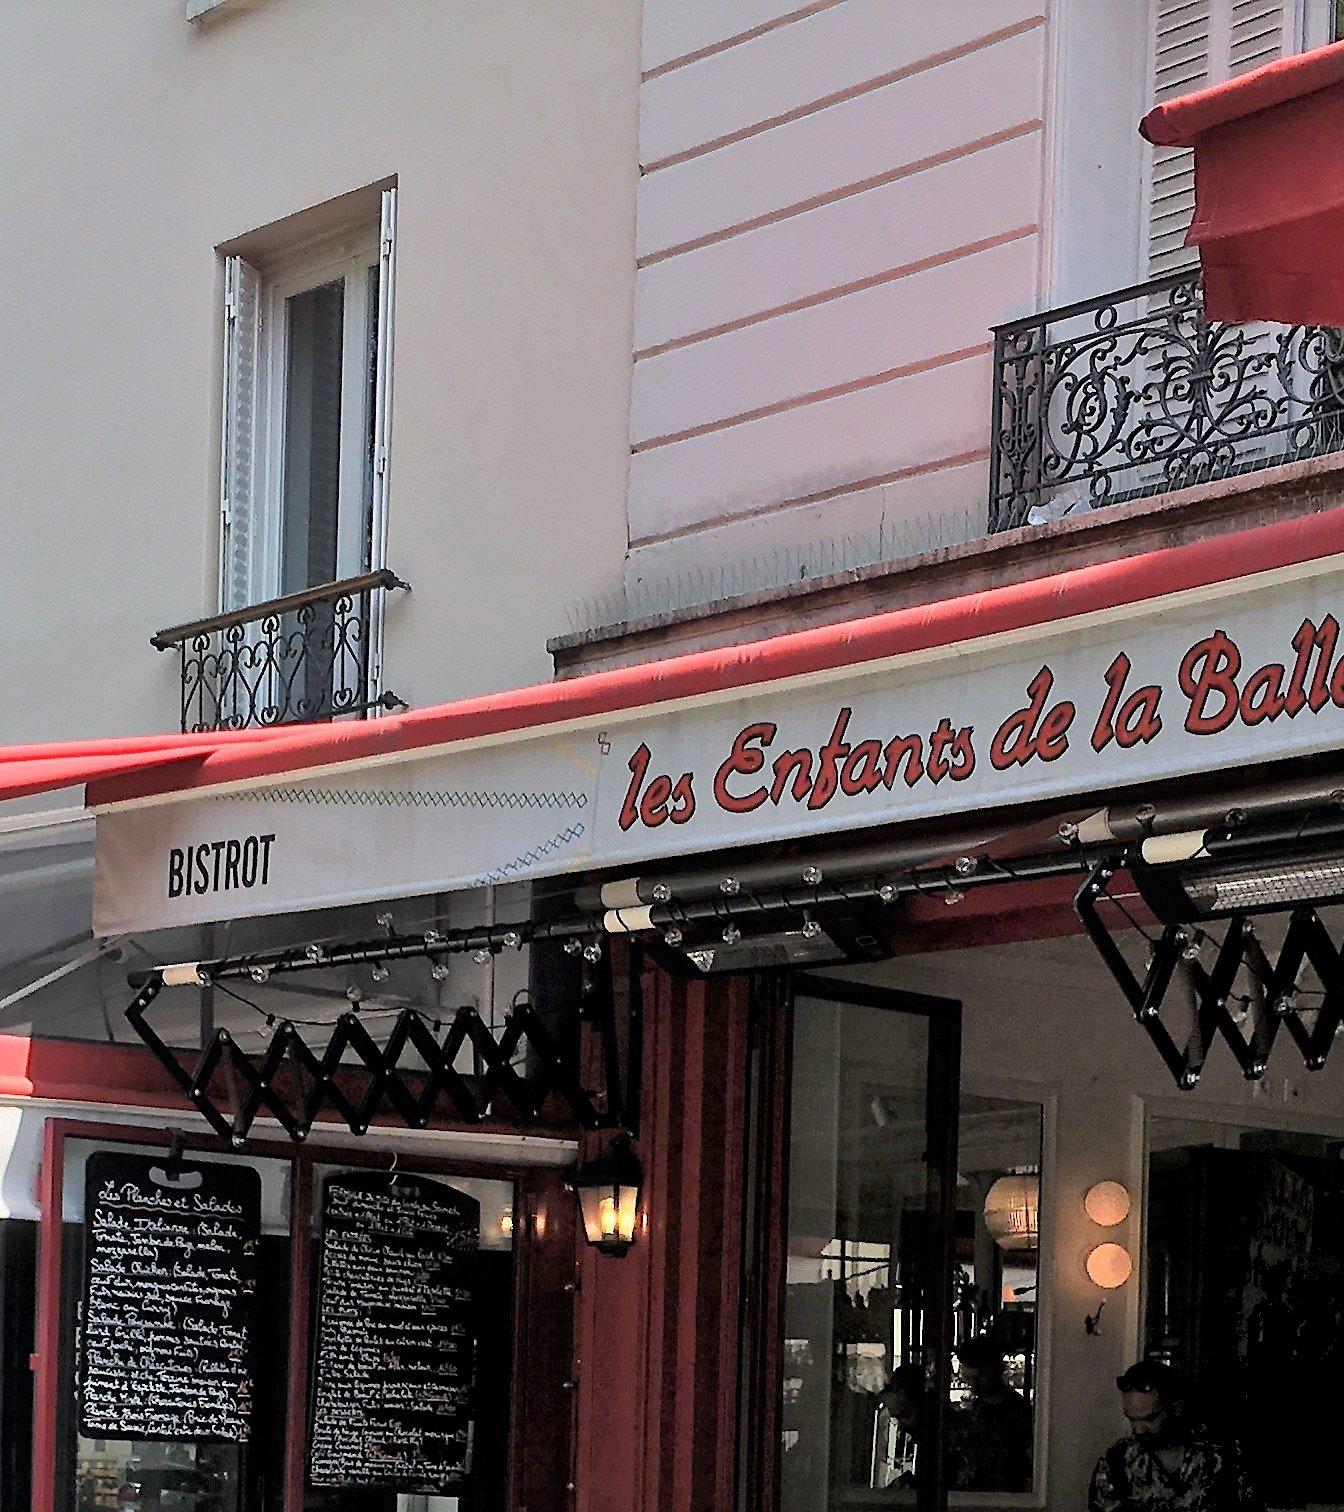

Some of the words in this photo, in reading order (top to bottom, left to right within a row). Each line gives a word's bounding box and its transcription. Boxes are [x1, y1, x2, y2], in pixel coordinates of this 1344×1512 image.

[618, 742, 696, 832] les
[713, 707, 976, 813] Enfants
[989, 664, 1076, 771] de
[1090, 651, 1163, 753] la
[168, 833, 276, 898] BISTROT
